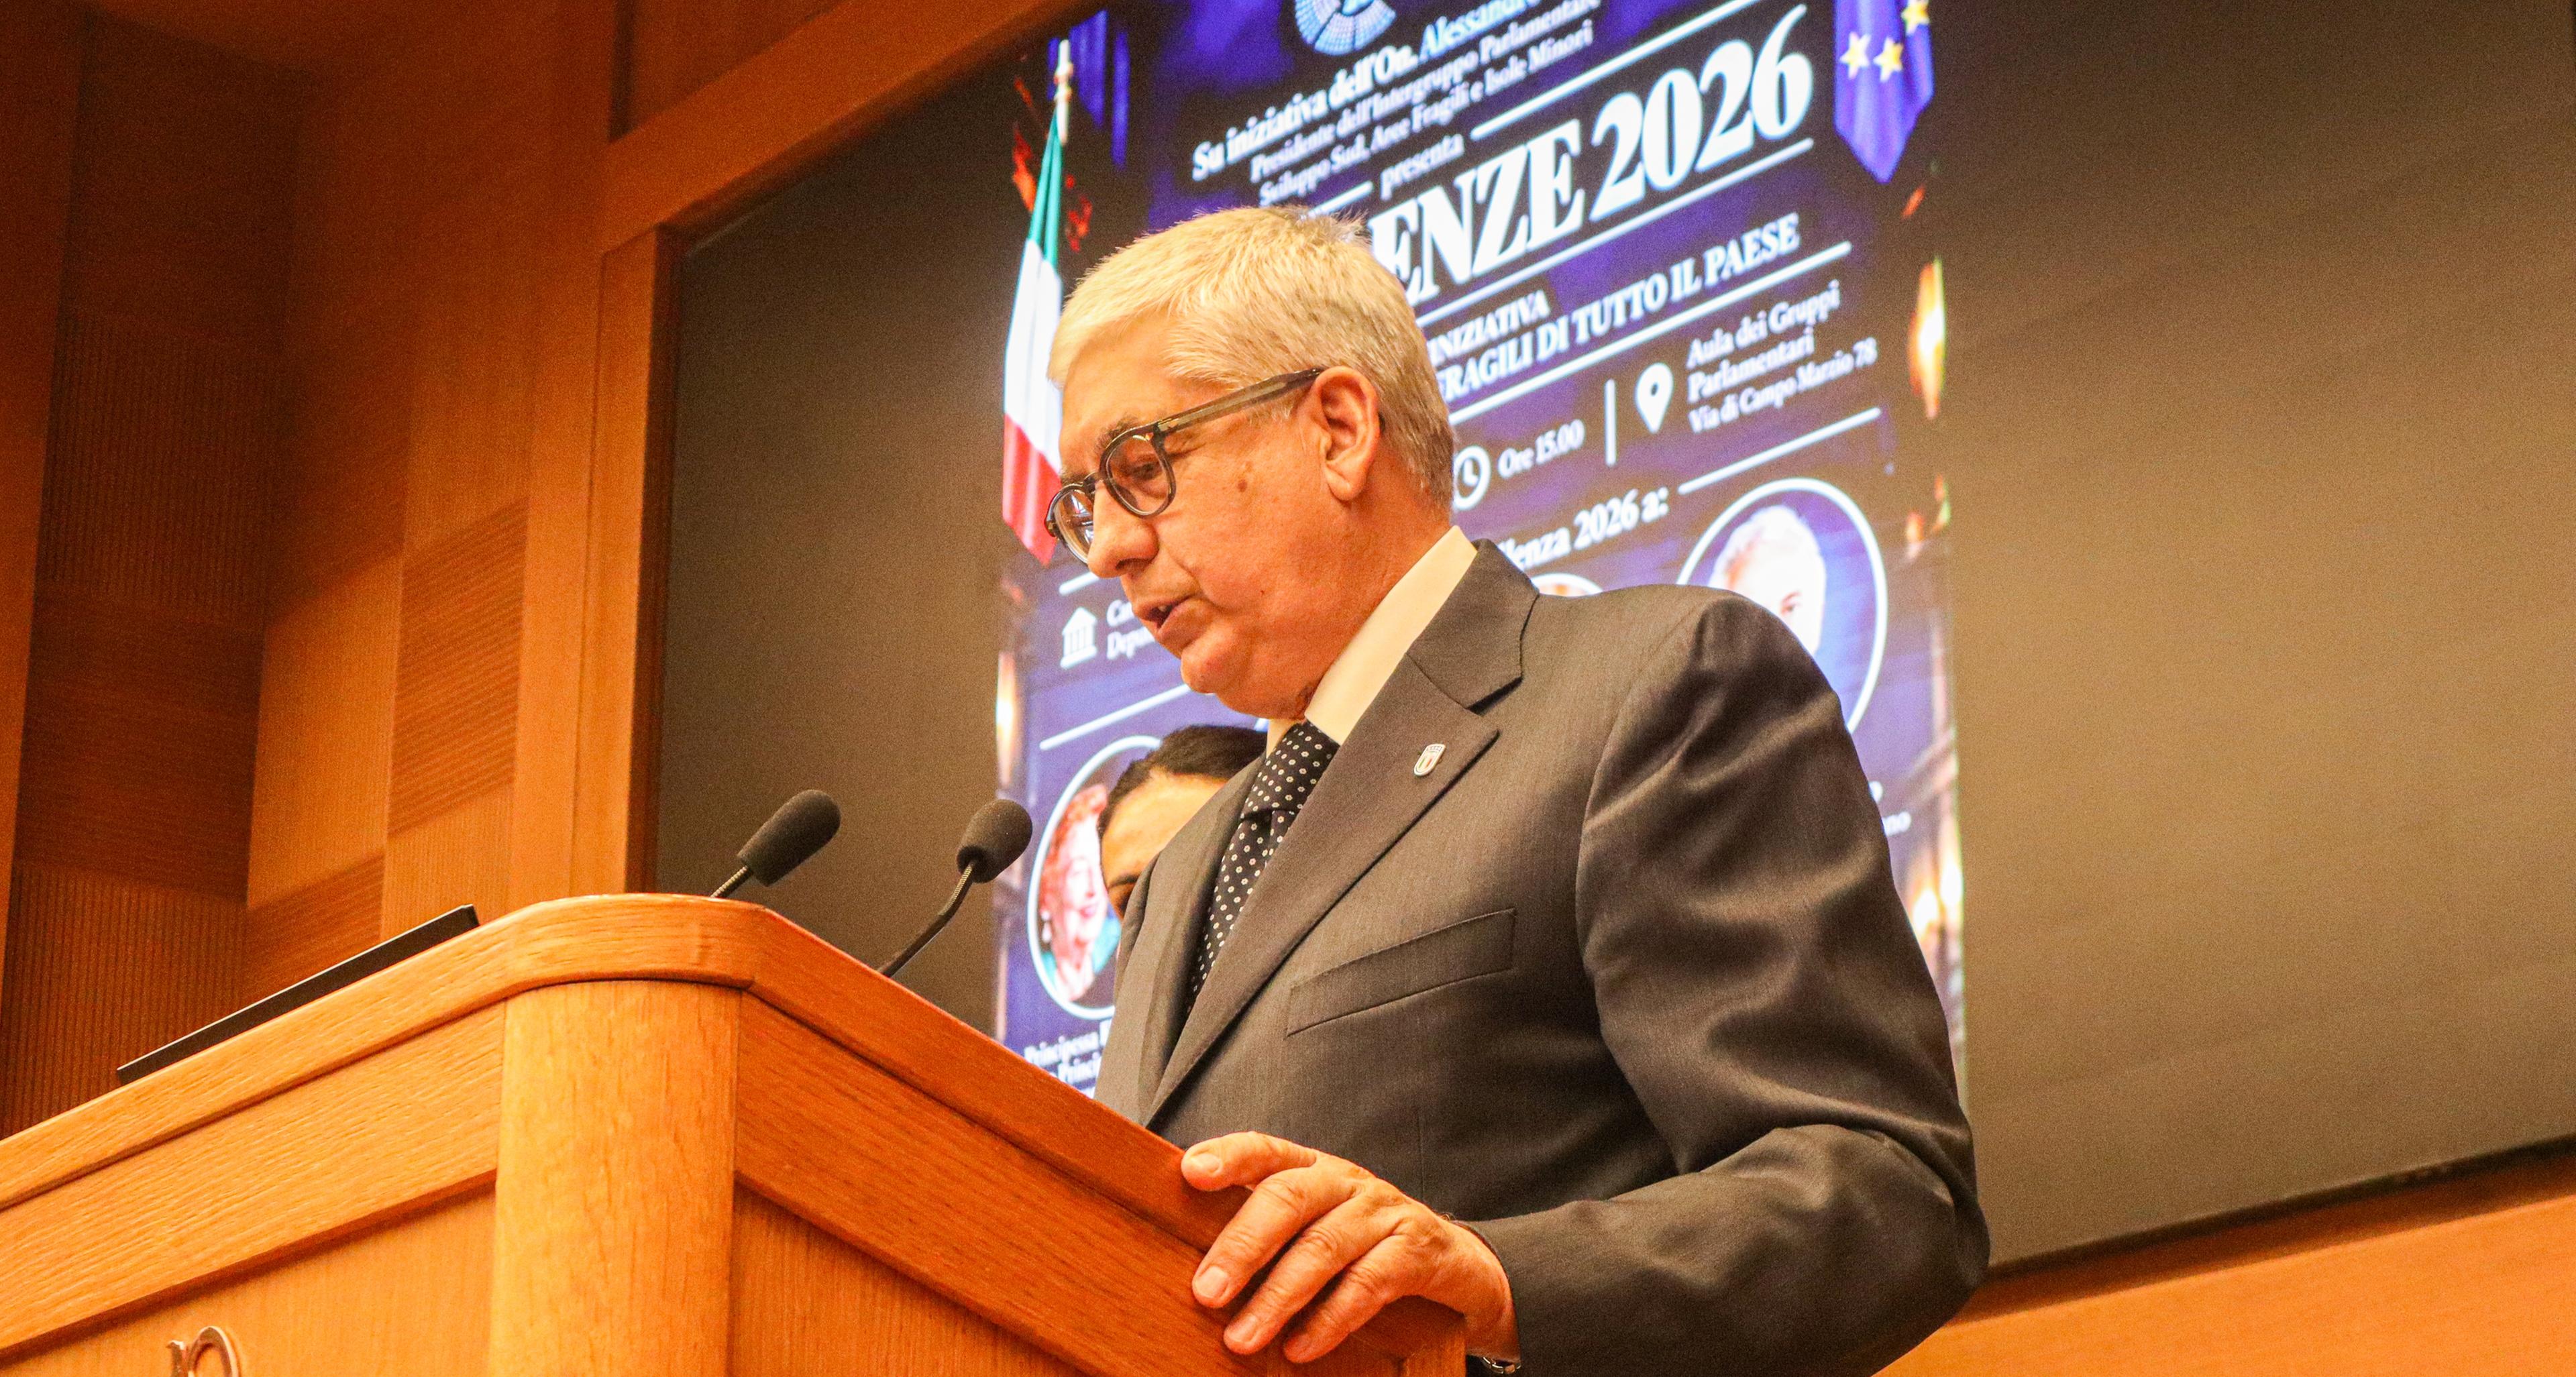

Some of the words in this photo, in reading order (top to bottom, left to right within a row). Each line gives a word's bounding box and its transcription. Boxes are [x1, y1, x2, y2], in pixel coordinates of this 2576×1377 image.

[1191, 141, 1226, 182] Su
[1226, 89, 1329, 164] iniziativa
[1328, 45, 1419, 111] dell'On.
[1250, 123, 1336, 184] Presidente
[1336, 50, 1479, 138] dell'Intergruppo
[1259, 158, 1332, 207] Sviluppo
[1371, 117, 1410, 154] Aree
[1411, 81, 1470, 133] Fragili
[1469, 80, 1484, 103] e
[1484, 54, 1528, 97] Isole
[1527, 18, 1594, 74] Minori
[1589, 3, 1813, 223] 2026
[1380, 133, 1466, 201] presenta
[1426, 289, 1552, 368] INIZIATIVA
[1536, 313, 1570, 362] DI
[1571, 272, 1669, 345] TUTTO
[1670, 257, 1703, 302] IL
[1703, 212, 1801, 287] PAESE
[1686, 326, 1735, 370] Aula
[1735, 310, 1769, 350] dei
[1768, 278, 1841, 334] Gruppi
[1686, 325, 1816, 404] Parlamentari
[1687, 404, 1721, 435] Via
[1719, 392, 1740, 424] di
[1739, 376, 1798, 415] Campo
[1795, 349, 1855, 394] Marzio
[1853, 336, 1878, 369] 78
[1497, 447, 1536, 479] Ore
[1535, 418, 1586, 465] 15.00
[1573, 488, 1640, 551] 2026
[1641, 486, 1670, 523] a:
